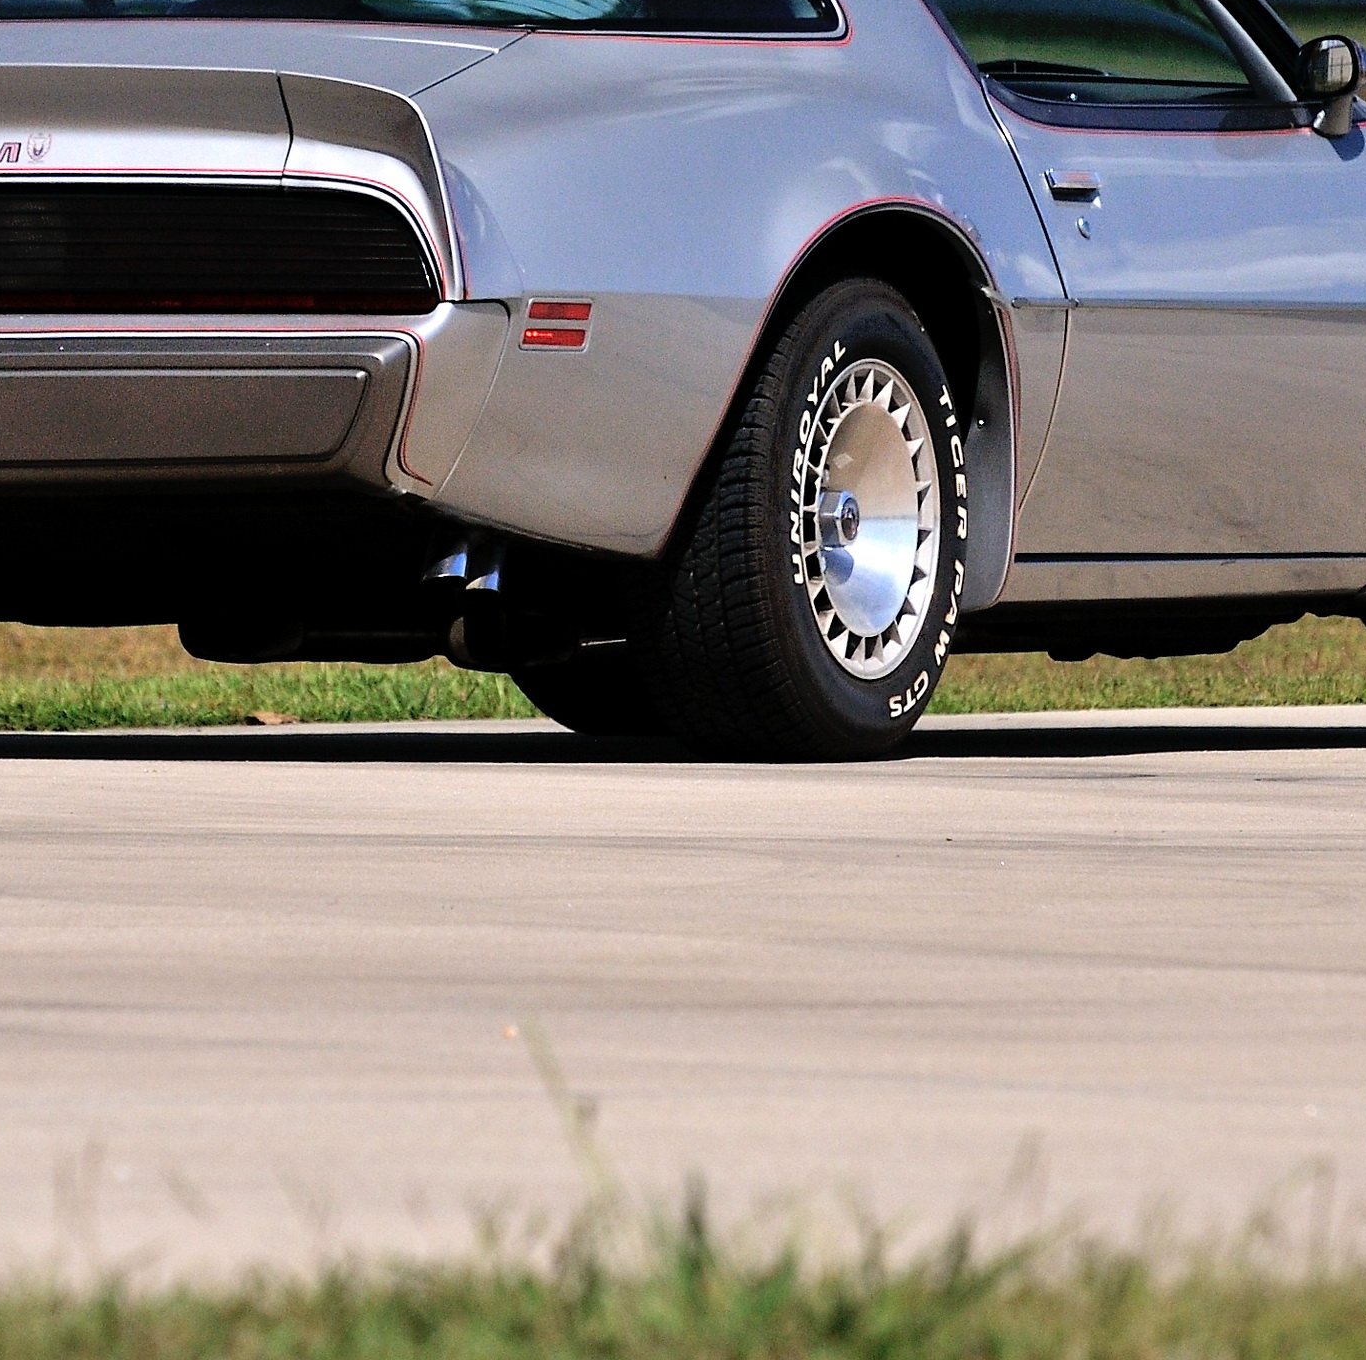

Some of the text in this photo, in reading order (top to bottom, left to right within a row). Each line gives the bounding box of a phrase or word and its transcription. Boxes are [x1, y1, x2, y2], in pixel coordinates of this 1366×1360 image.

[790, 340, 846, 585] UNIROYAL
[888, 384, 968, 719] TIGER PAW GTS
